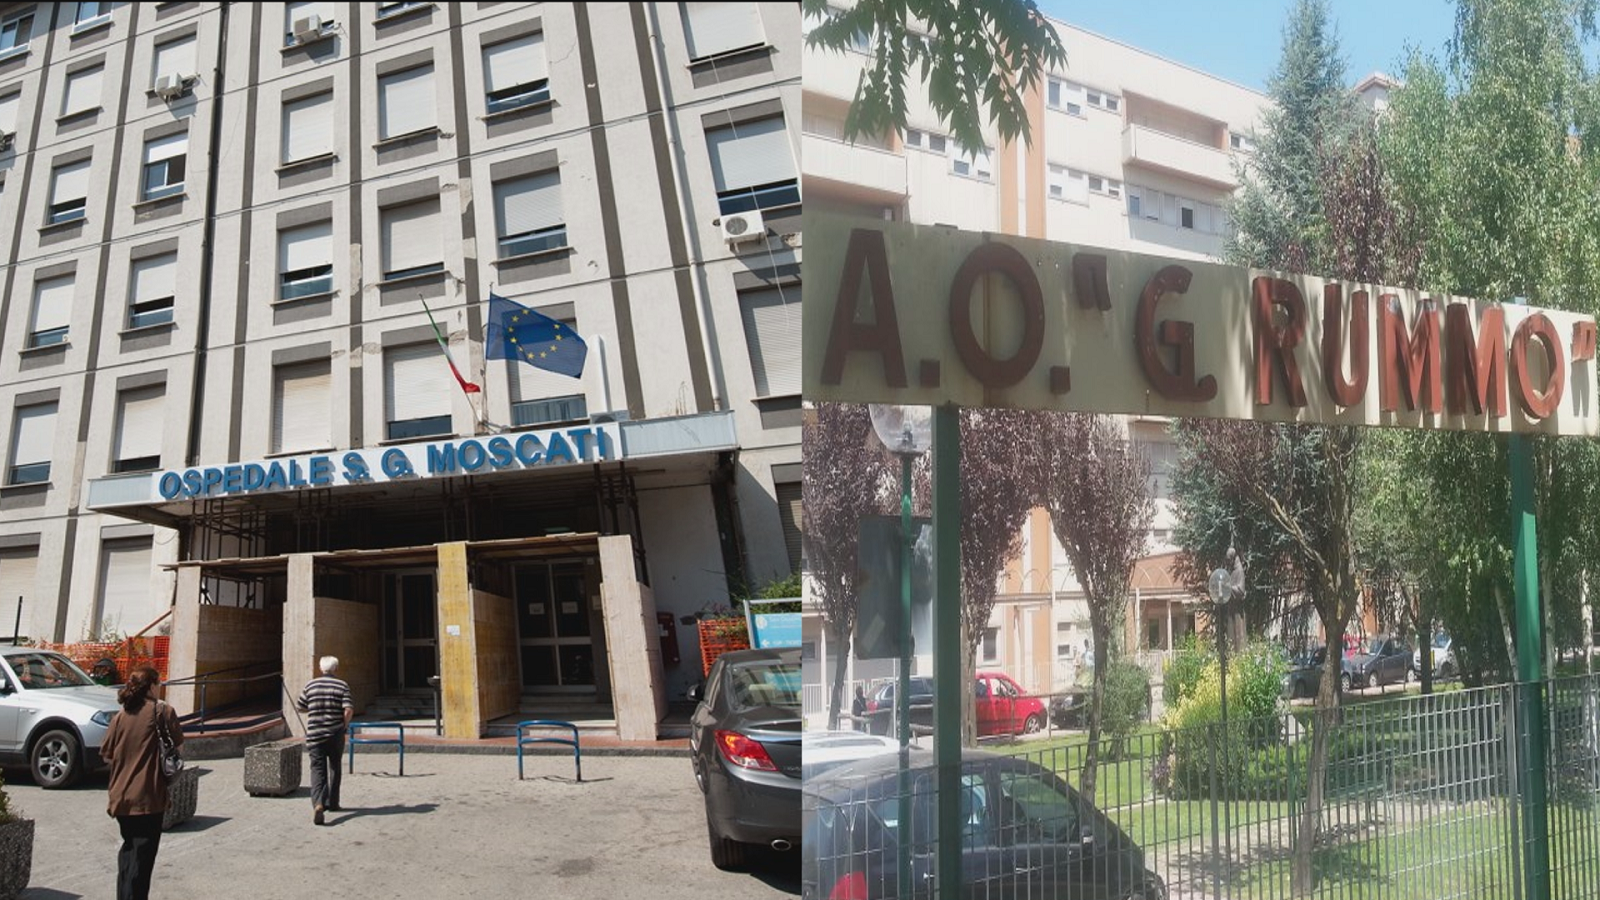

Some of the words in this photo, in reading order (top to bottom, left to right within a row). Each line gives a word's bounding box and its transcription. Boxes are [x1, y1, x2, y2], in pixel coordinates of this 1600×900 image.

[158, 456, 331, 499] OSPEDALE
[342, 451, 371, 480] S.
[380, 447, 414, 478] G.
[426, 426, 606, 472] MOSCATI
